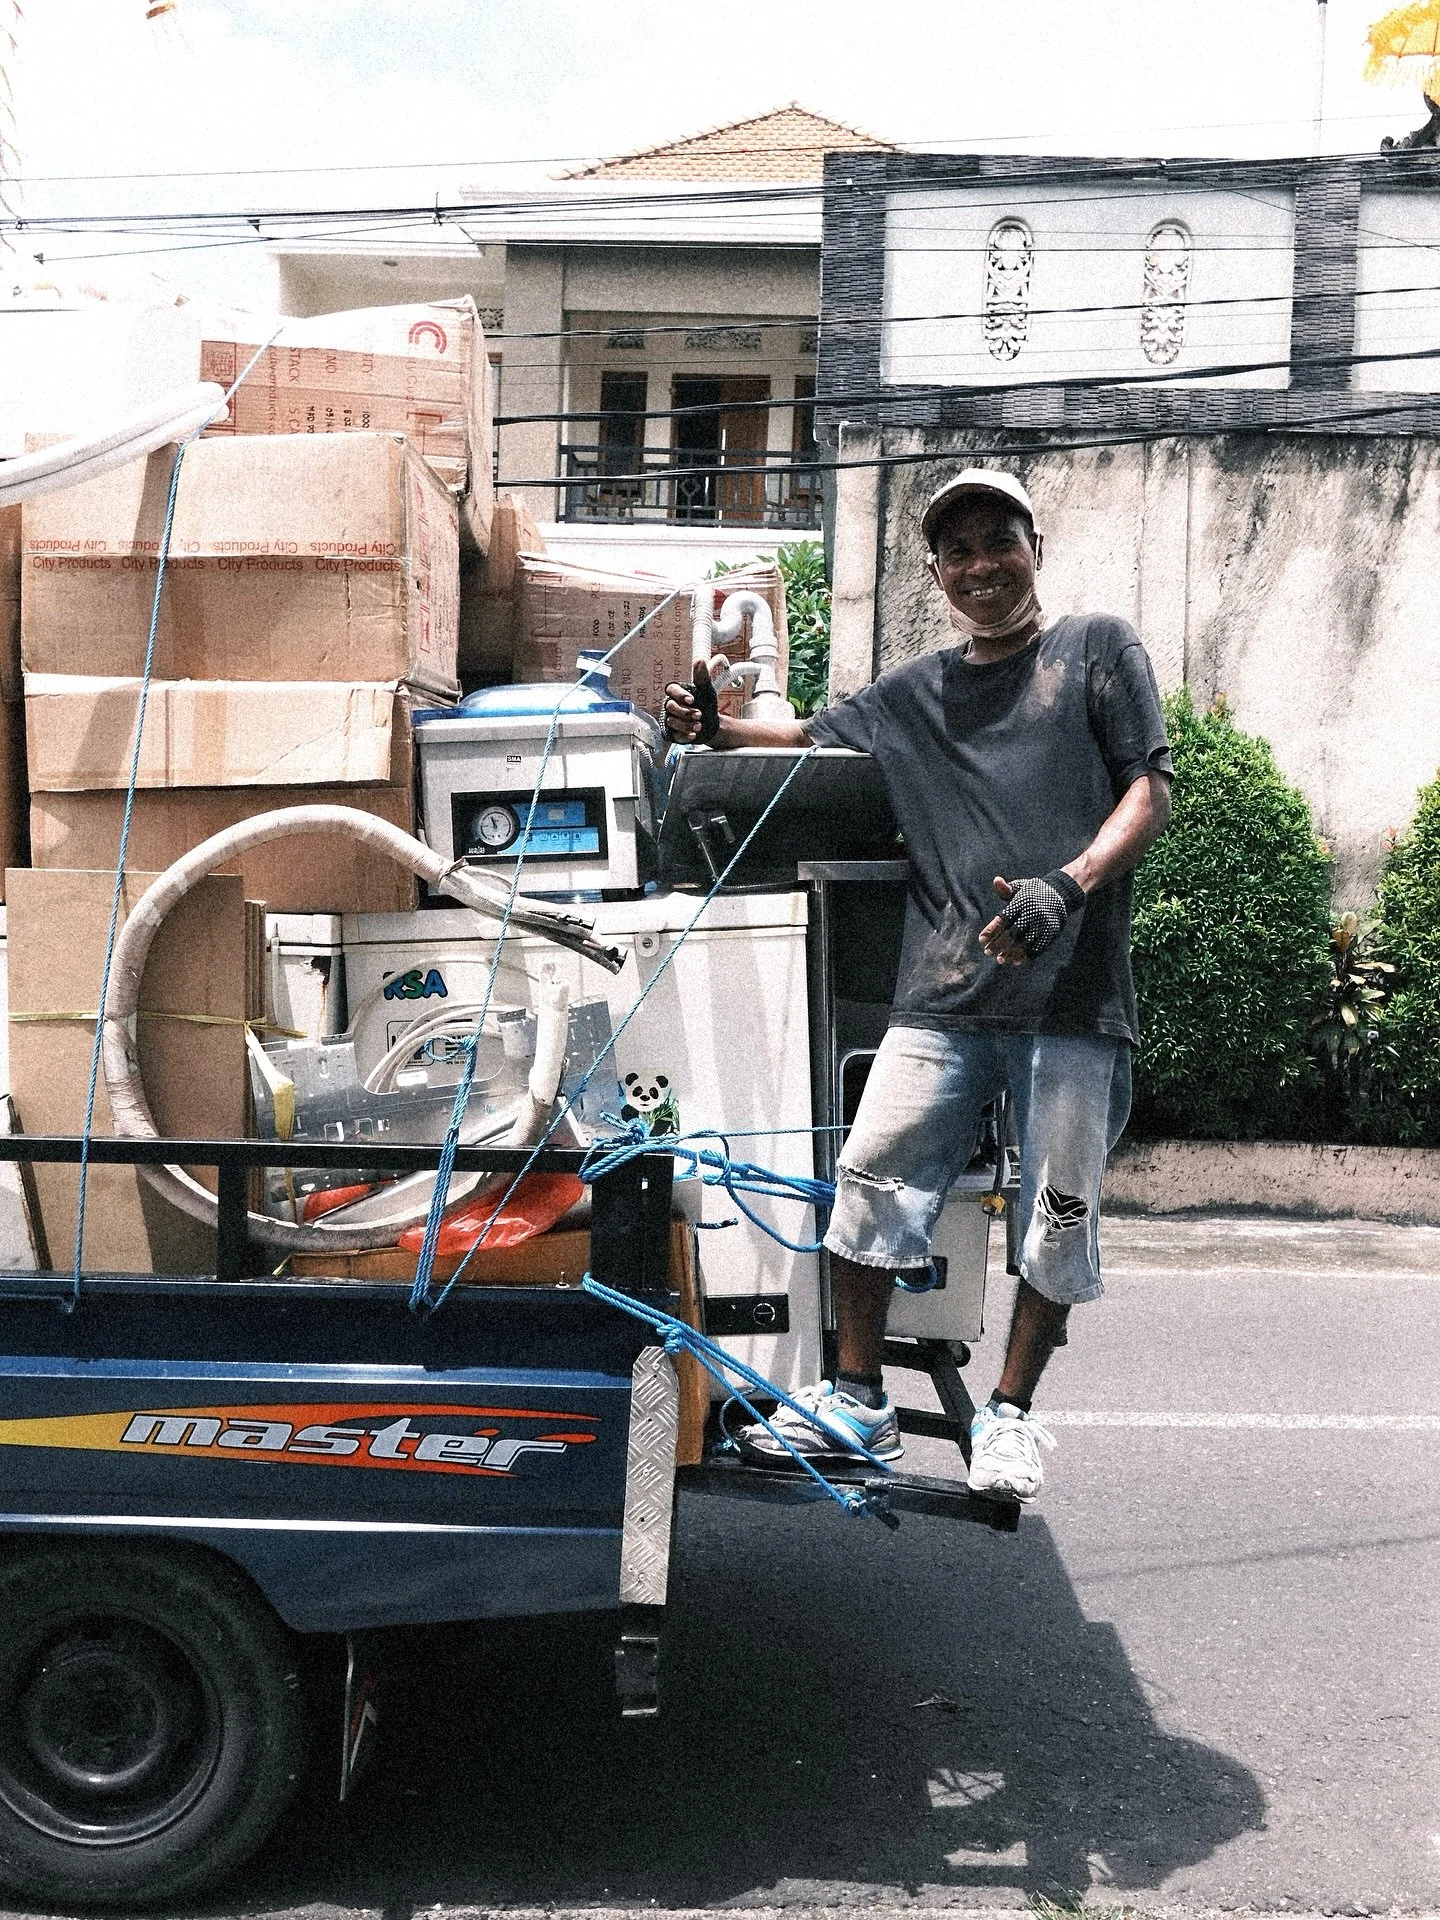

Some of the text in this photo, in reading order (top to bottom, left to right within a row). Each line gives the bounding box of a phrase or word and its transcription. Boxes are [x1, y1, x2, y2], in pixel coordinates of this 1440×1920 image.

[288, 347, 303, 383] STACK
[29, 540, 80, 551] Products
[83, 540, 107, 552] City
[213, 541, 269, 553] Products
[273, 540, 299, 554] City
[310, 541, 367, 555] Products
[371, 541, 396, 556] City
[32, 556, 55, 570] City
[58, 556, 112, 569] Products
[121, 556, 145, 570] City
[217, 557, 243, 572] City
[246, 557, 304, 571] Products
[315, 558, 341, 573] City
[344, 559, 401, 572] Products
[621, 668, 632, 683] NO
[652, 658, 664, 691] STACK
[119, 1413, 568, 1473] master
